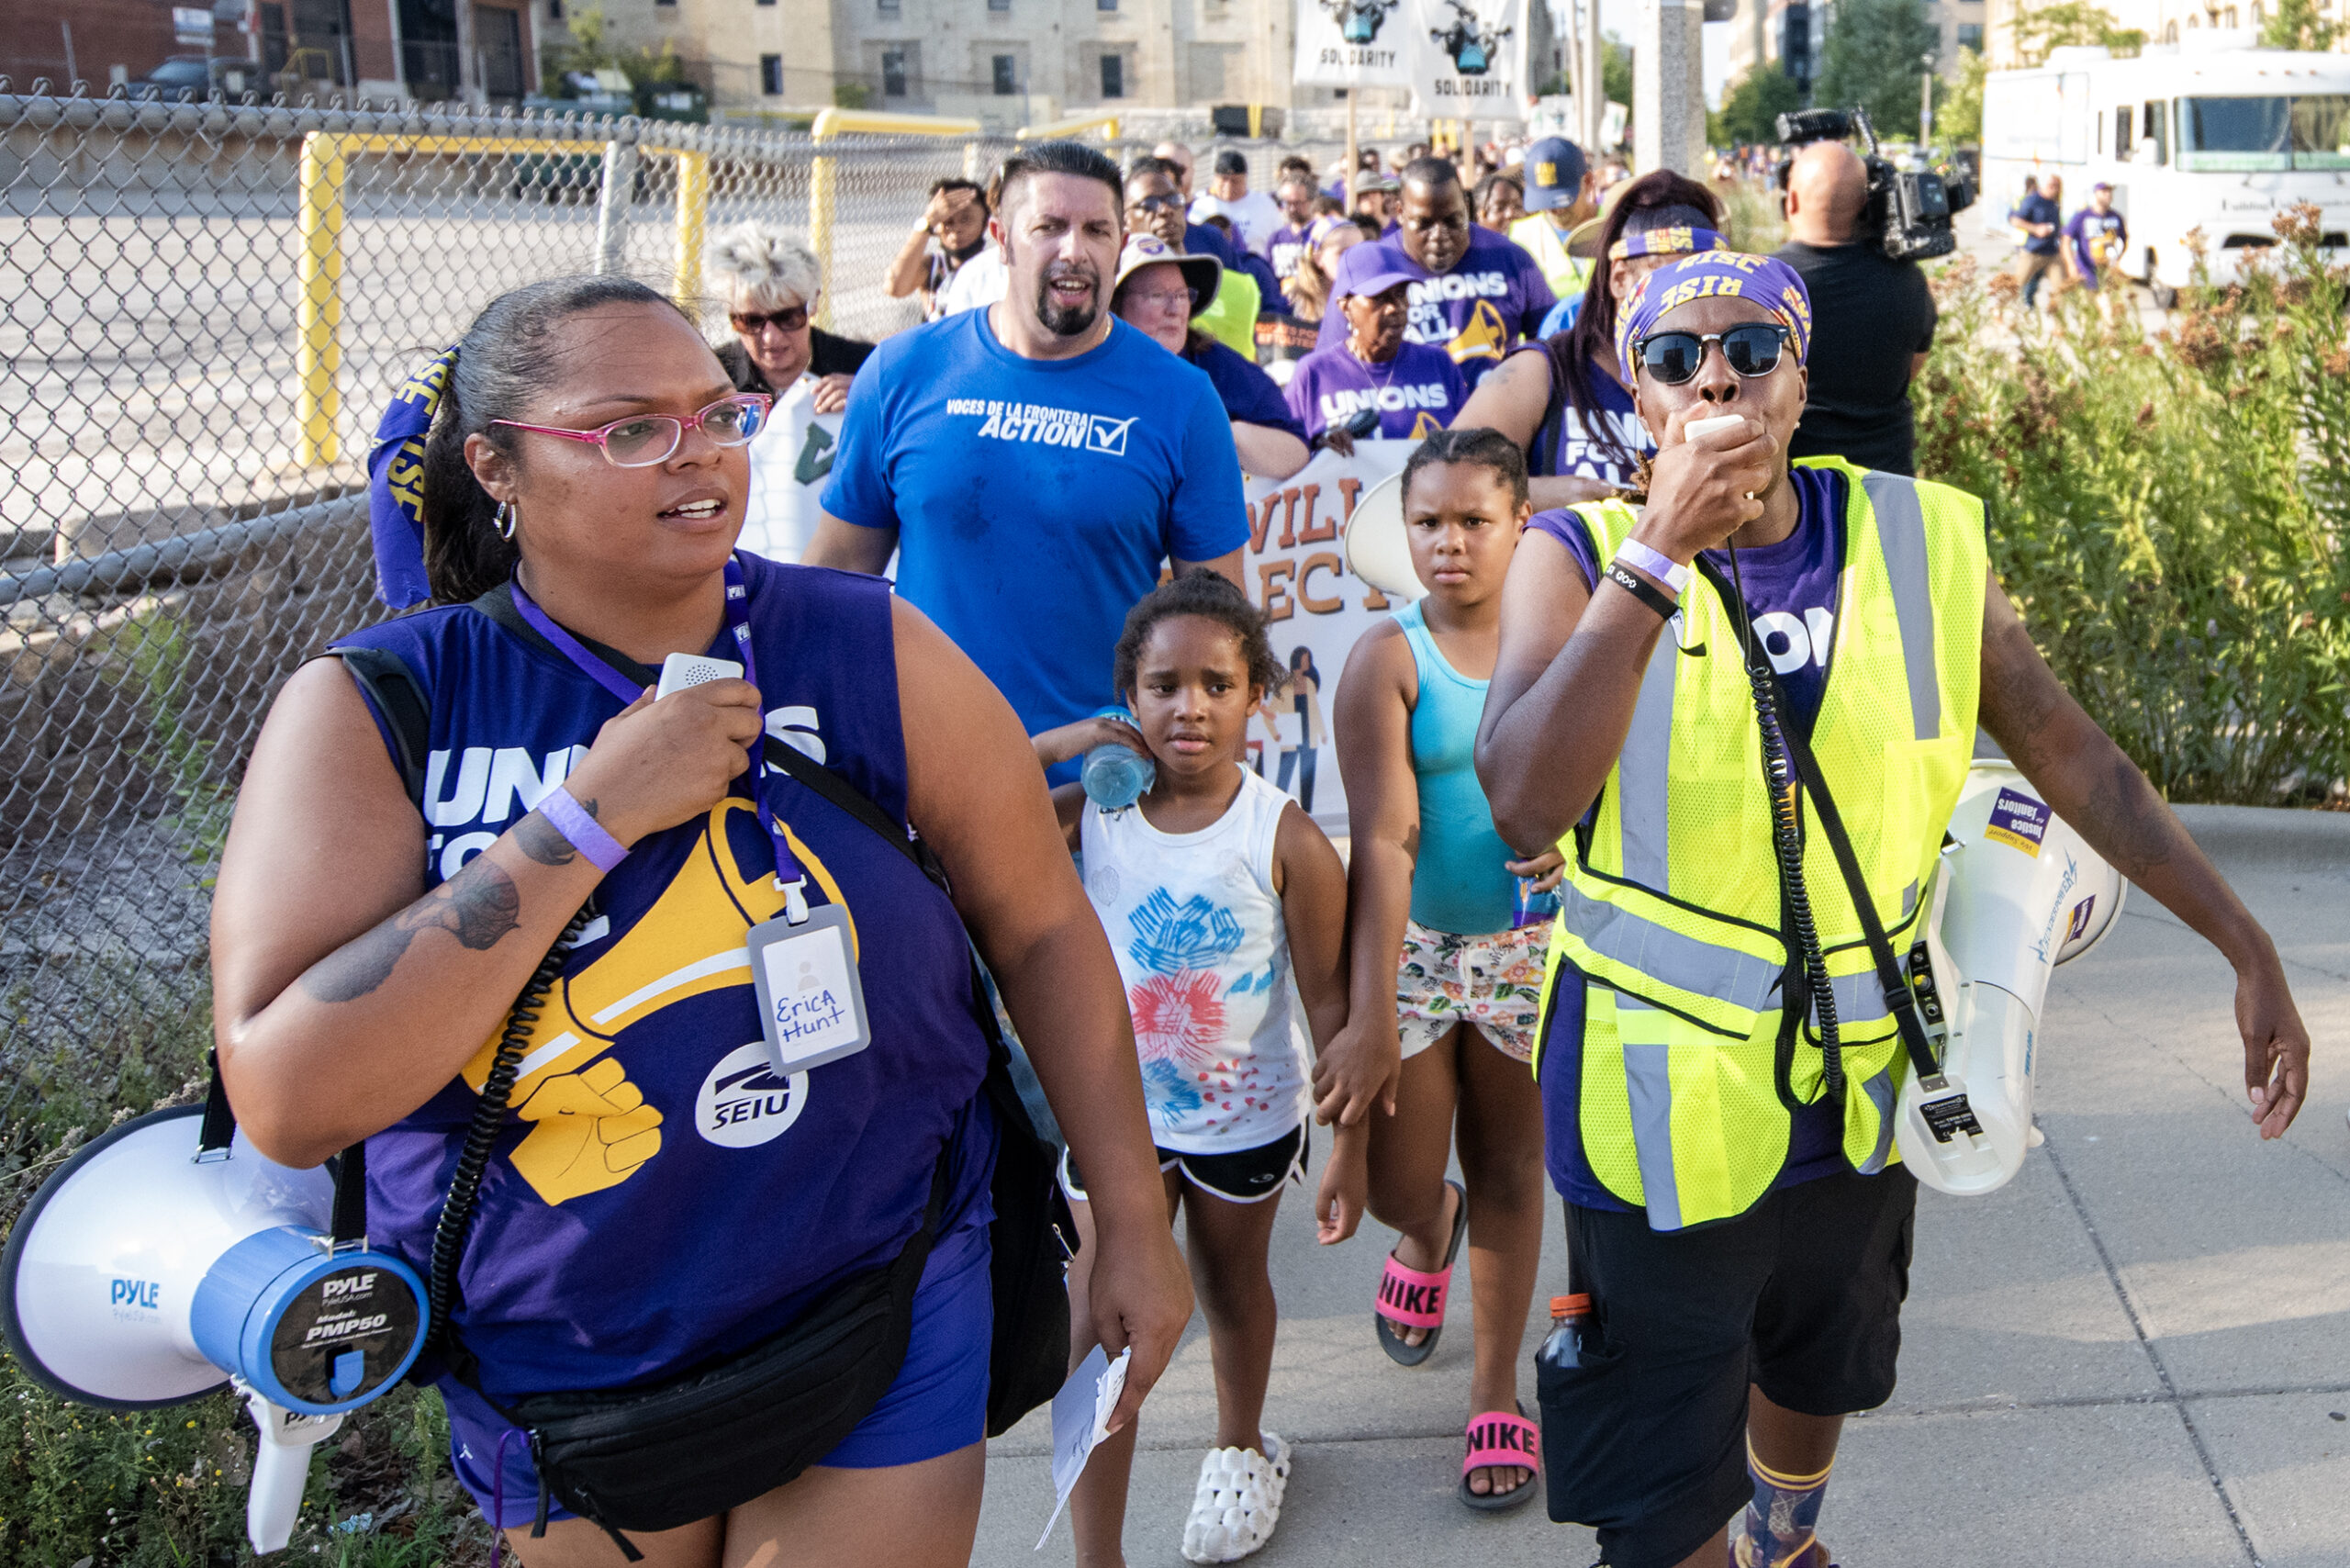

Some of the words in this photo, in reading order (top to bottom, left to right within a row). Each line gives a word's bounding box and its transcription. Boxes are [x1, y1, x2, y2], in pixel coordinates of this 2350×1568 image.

[1320, 48, 1396, 68] SOLDARITY
[1435, 78, 1512, 97] SOLIDARITY
[1406, 272, 1508, 306] NIONS
[1407, 303, 1441, 323] OR
[946, 398, 985, 416] VOCES
[987, 400, 1004, 416] DE
[1005, 402, 1022, 417] LA
[1024, 404, 1089, 428] FRONTERA
[1320, 384, 1449, 416] UNIONS
[978, 415, 1087, 449] ACTION
[1998, 798, 2038, 821] Janitors
[2010, 819, 2043, 839] Justice
[782, 1005, 845, 1043] Hunt
[711, 1092, 790, 1131] SEIU
[111, 1279, 160, 1310] PYLE
[321, 1272, 378, 1299] PYLE
[1379, 1271, 1442, 1315] NIKE
[305, 1313, 387, 1342] PMP50
[1468, 1422, 1537, 1456] NIKE
